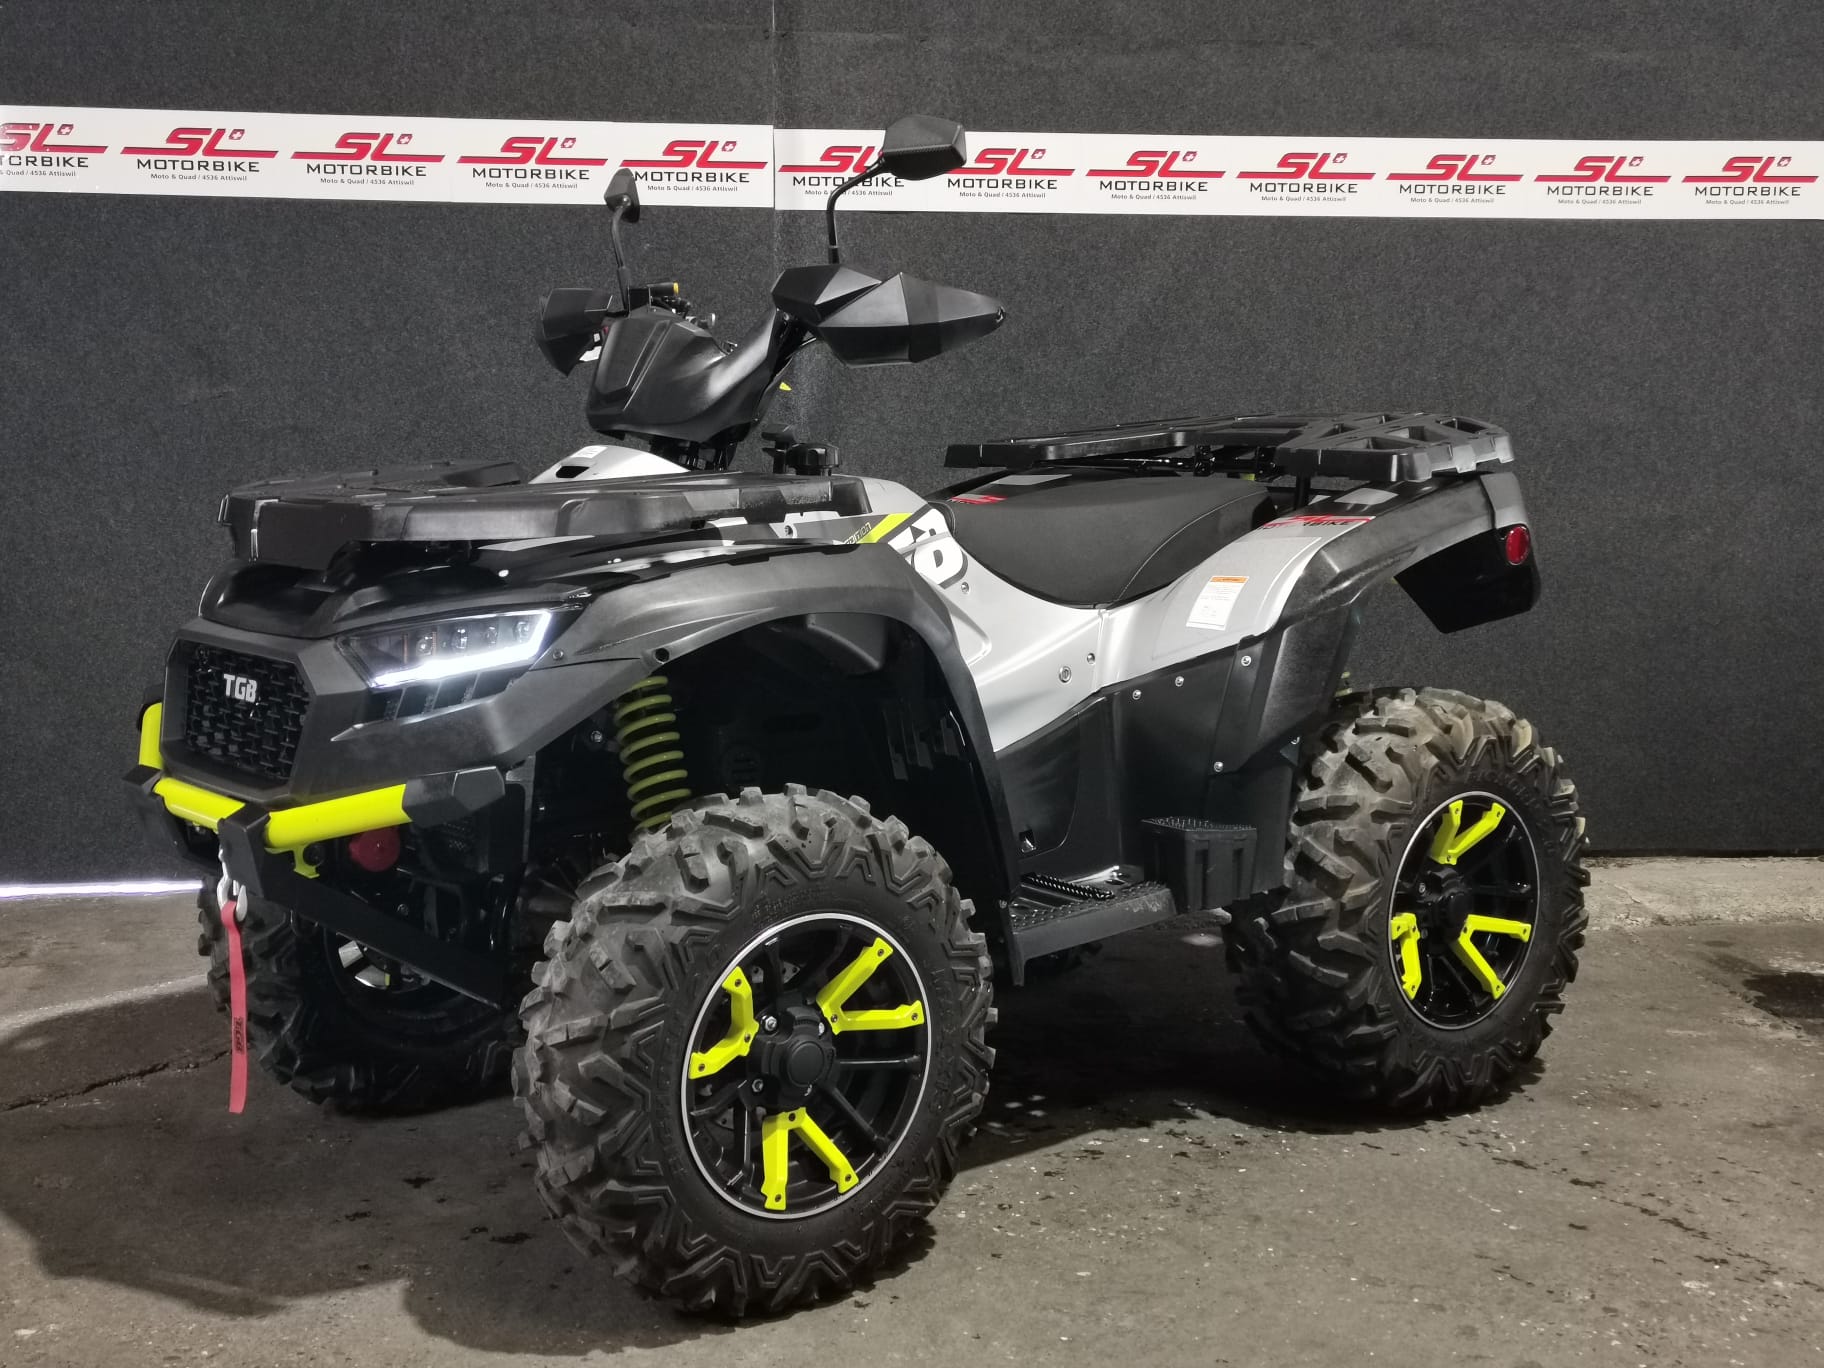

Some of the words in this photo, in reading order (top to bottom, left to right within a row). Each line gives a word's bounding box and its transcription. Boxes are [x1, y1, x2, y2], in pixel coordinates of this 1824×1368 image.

[137, 158, 260, 172] MOTORBIKE
[306, 163, 427, 177] MOTORBIKE
[5, 169, 25, 177] Quad
[150, 173, 170, 181] Moto
[177, 173, 196, 181] Quad
[472, 168, 590, 180] MOTORBIKE
[634, 171, 750, 183] MOTORBIKE
[320, 177, 339, 185] Moto
[346, 177, 365, 185] Quad
[793, 176, 904, 187] MOTOBIKE
[947, 178, 1058, 189] MOTORBIKE
[1099, 181, 1209, 192] MOTORBIKE
[647, 184, 665, 192] Moto
[672, 184, 690, 192] Quad
[1250, 182, 1358, 193] MOTORBIKE
[1399, 184, 1506, 195] MOTORBIKE
[1547, 185, 1654, 196] MOTORBIKE
[1695, 186, 1801, 196] MOTORBIKE
[223, 673, 258, 703] TGB
